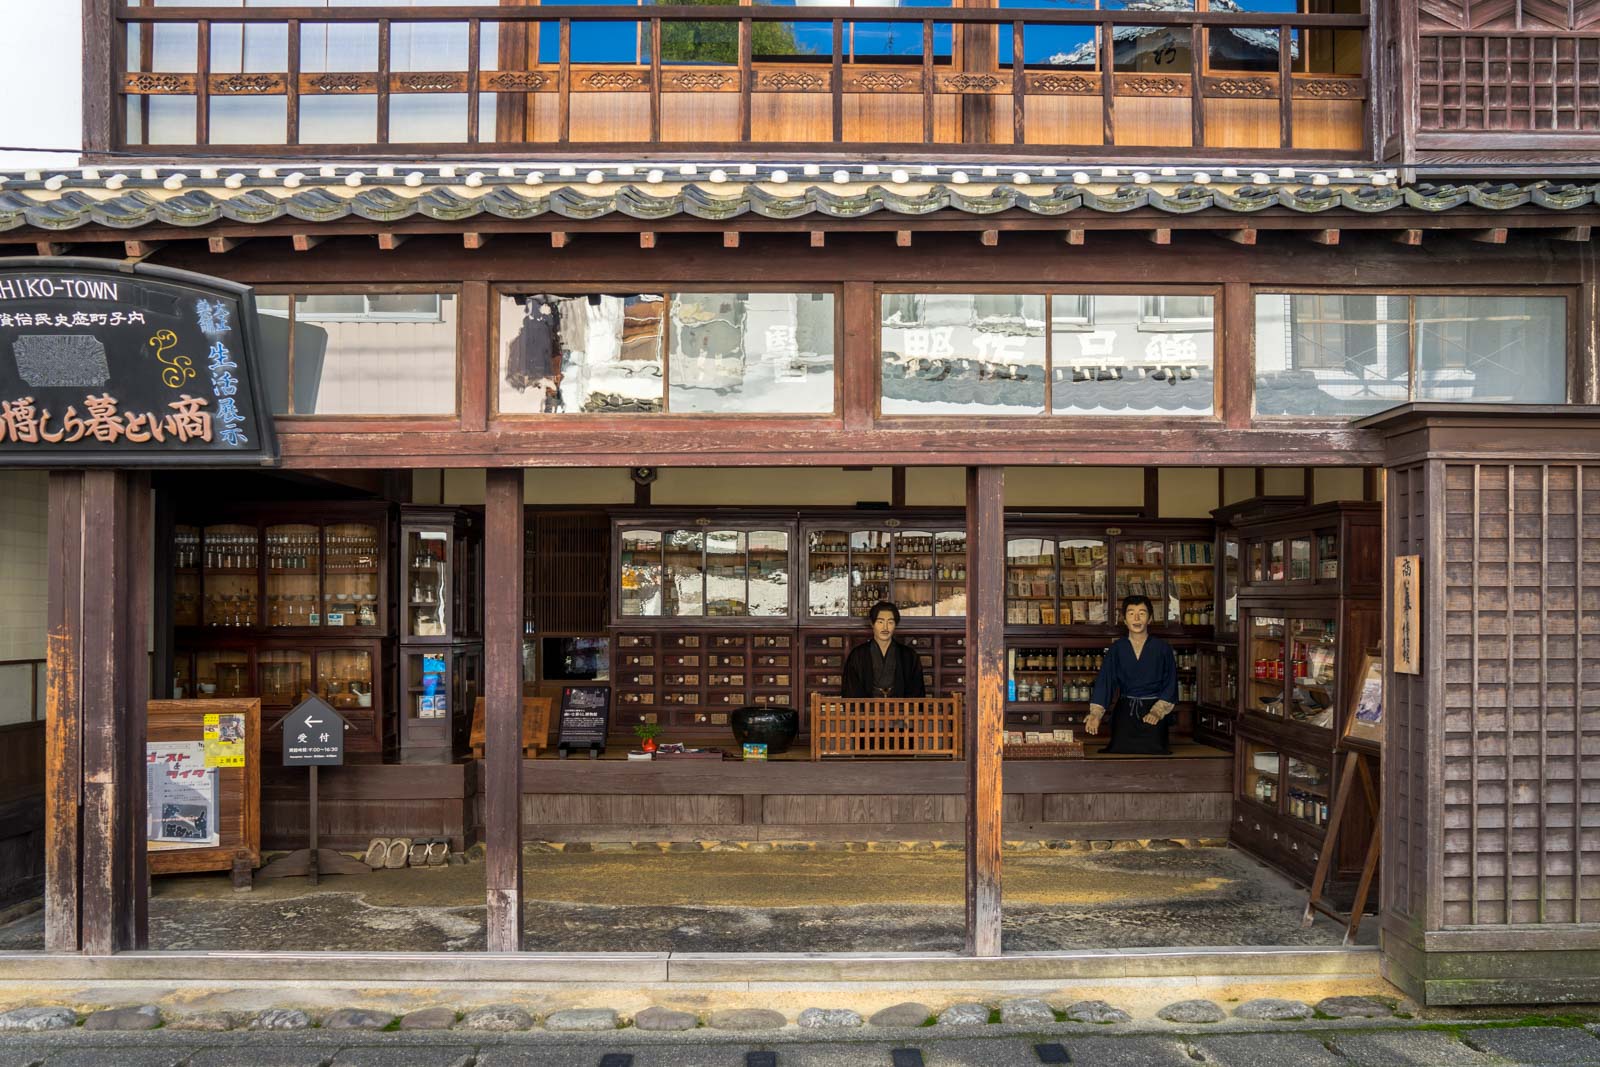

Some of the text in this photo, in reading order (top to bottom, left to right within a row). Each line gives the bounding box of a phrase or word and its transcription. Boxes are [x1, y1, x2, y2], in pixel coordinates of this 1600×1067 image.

[0, 278, 118, 300] HIKO-TOWN
[207, 341, 249, 446] 生活展示
[0, 392, 214, 444] 商いと暮らし博
[297, 732, 331, 744] 受付
